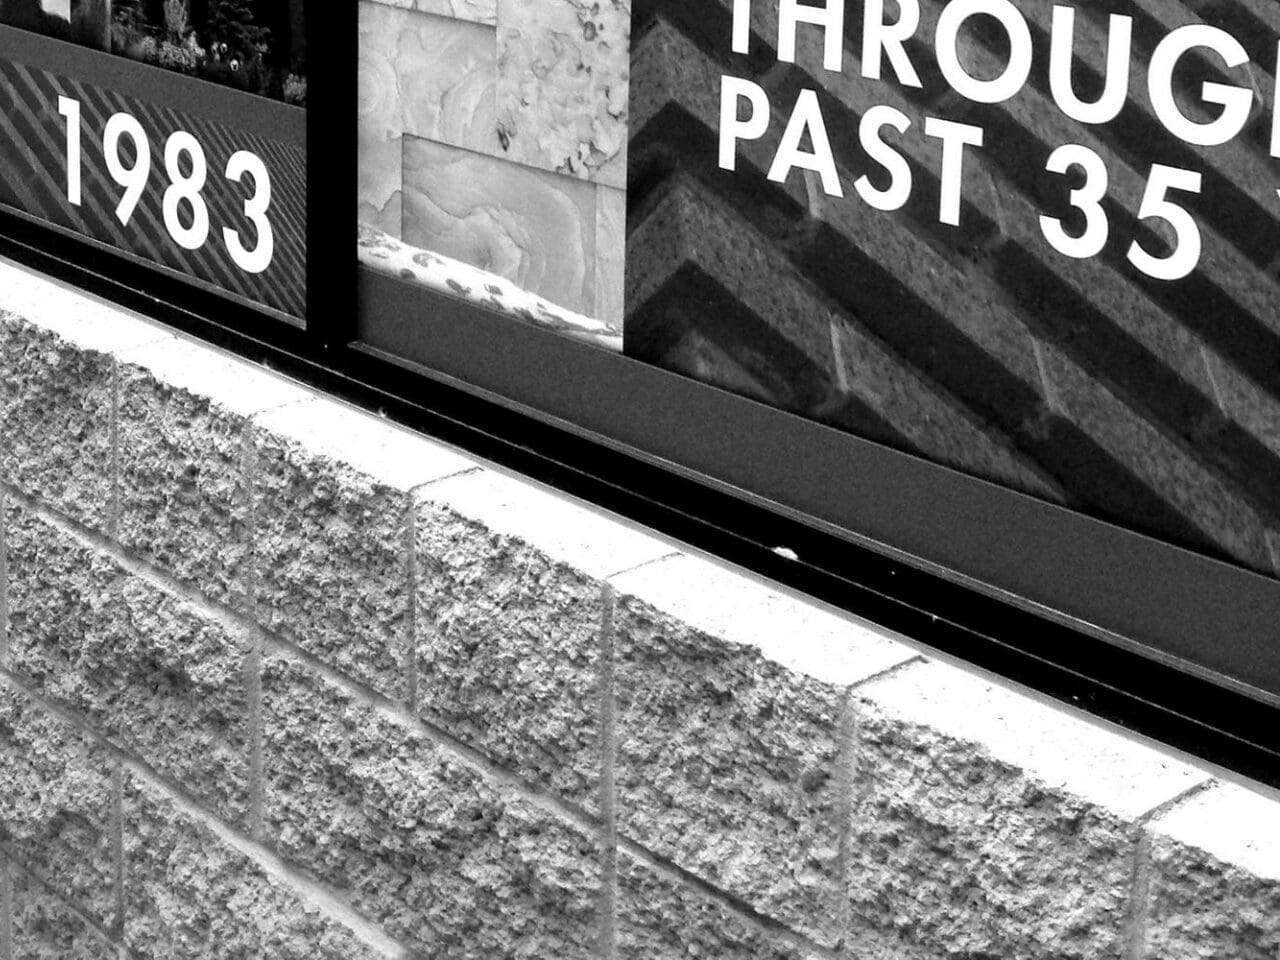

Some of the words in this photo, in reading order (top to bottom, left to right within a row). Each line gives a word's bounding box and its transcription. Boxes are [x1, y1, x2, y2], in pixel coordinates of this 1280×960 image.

[58, 95, 274, 274] 1983
[718, 74, 984, 227] PAST
[1038, 143, 1203, 281] 35
